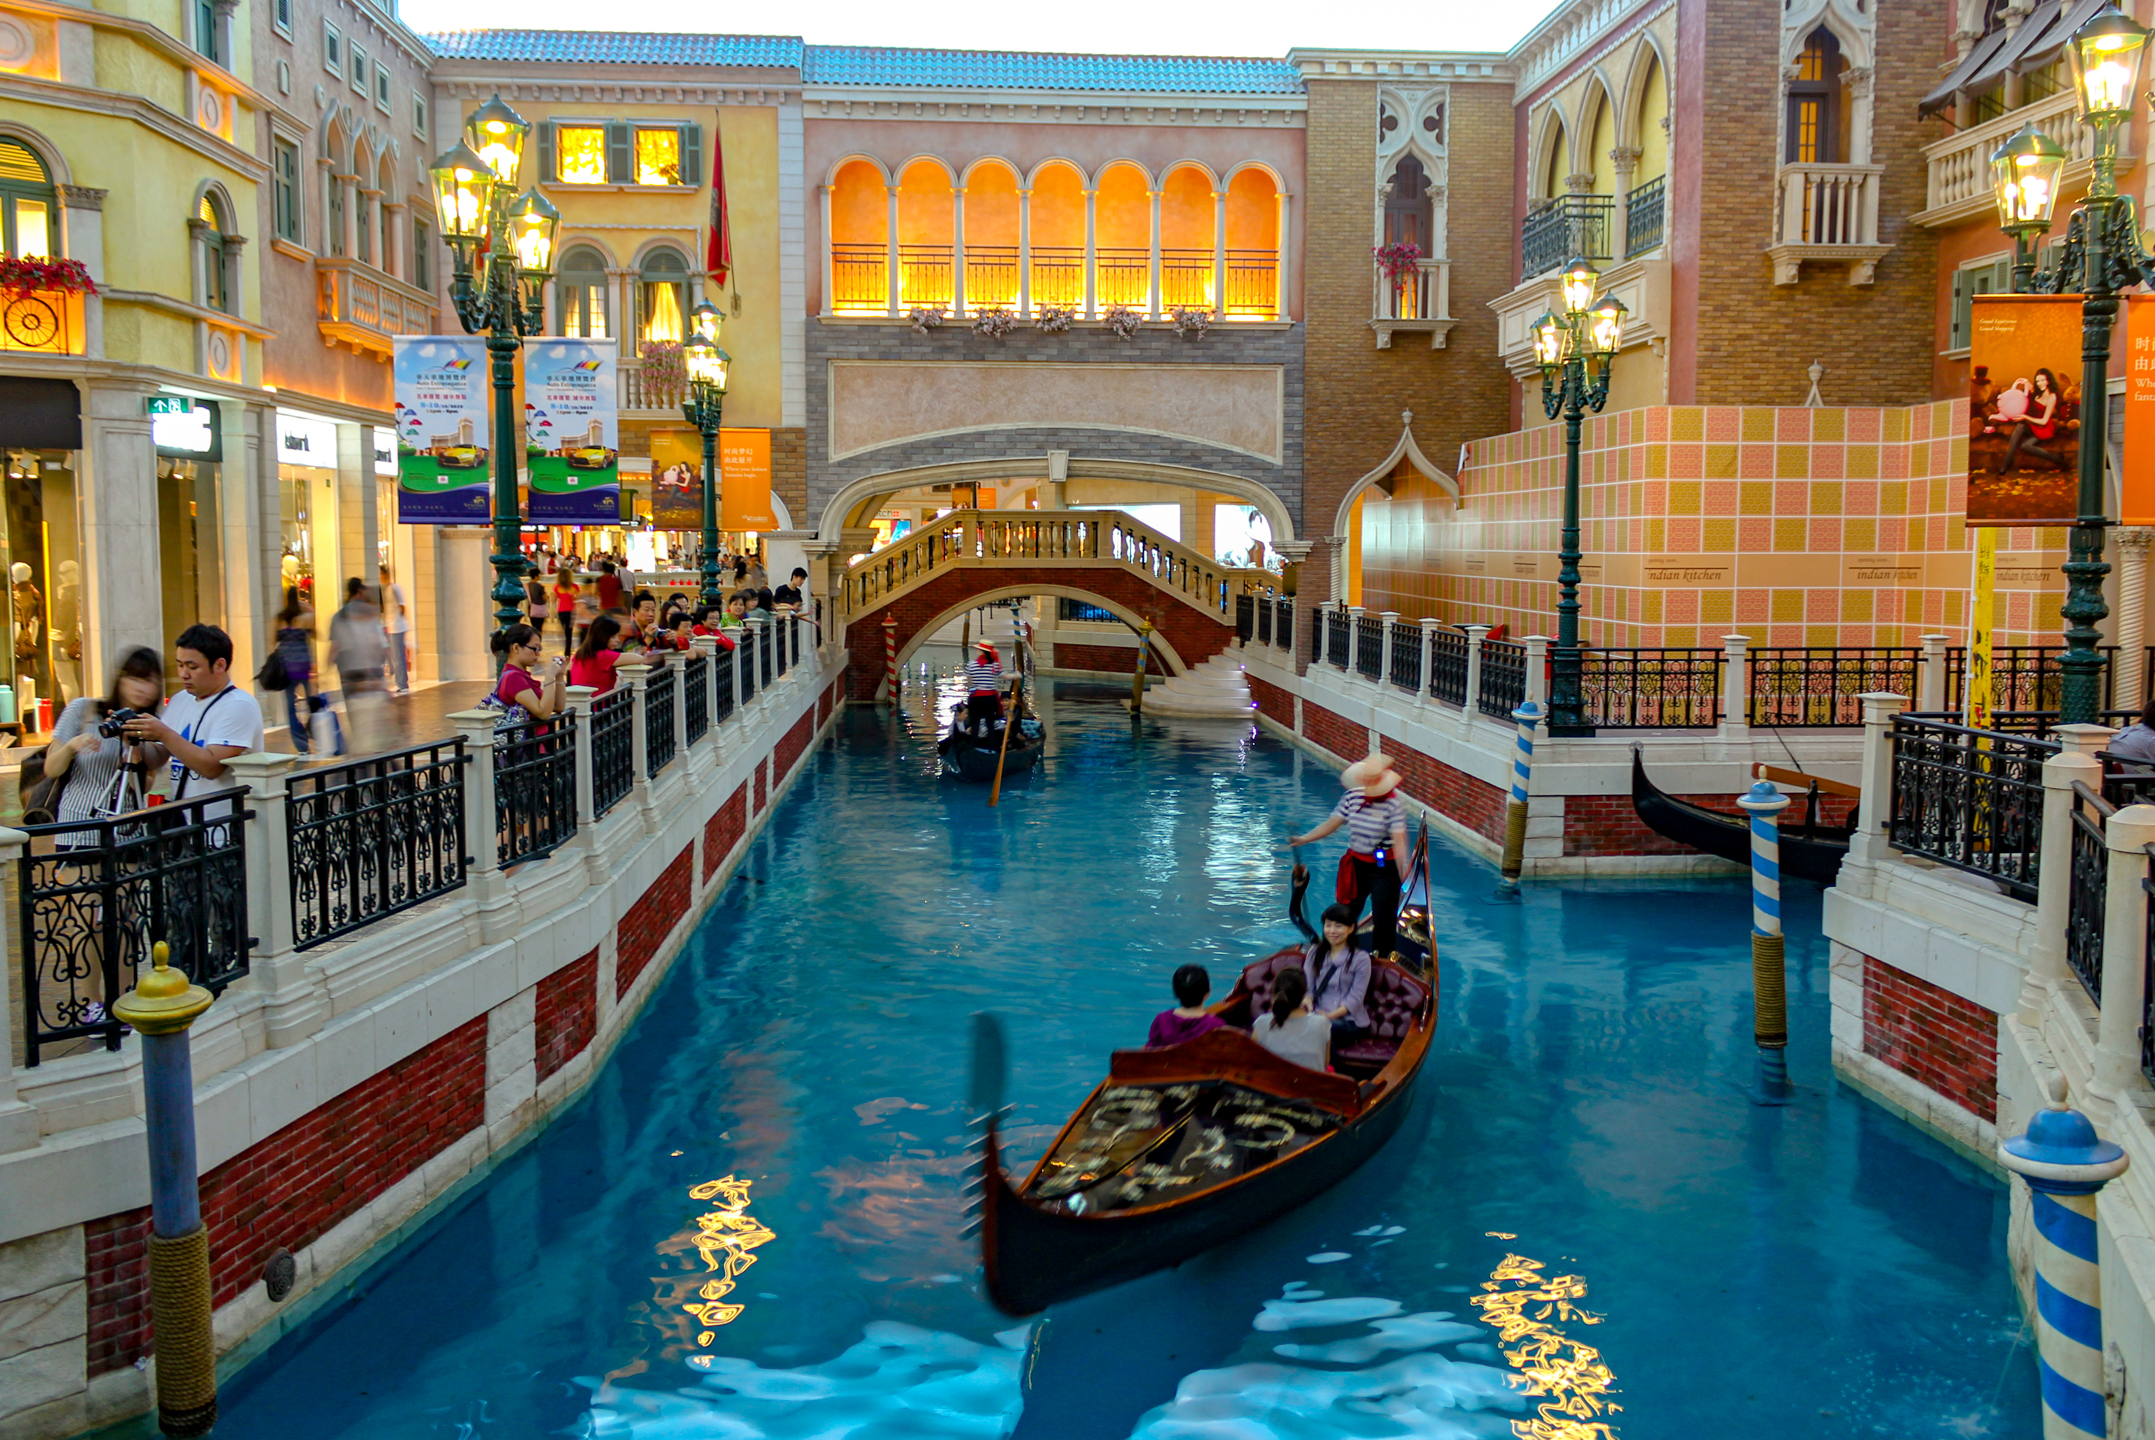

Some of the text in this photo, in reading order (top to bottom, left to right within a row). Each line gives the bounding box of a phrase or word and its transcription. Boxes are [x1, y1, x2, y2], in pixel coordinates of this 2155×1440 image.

[1683, 568, 1721, 582] kitchen
[1857, 569, 1891, 579] indian
[1997, 569, 2050, 584] indian kitchen
